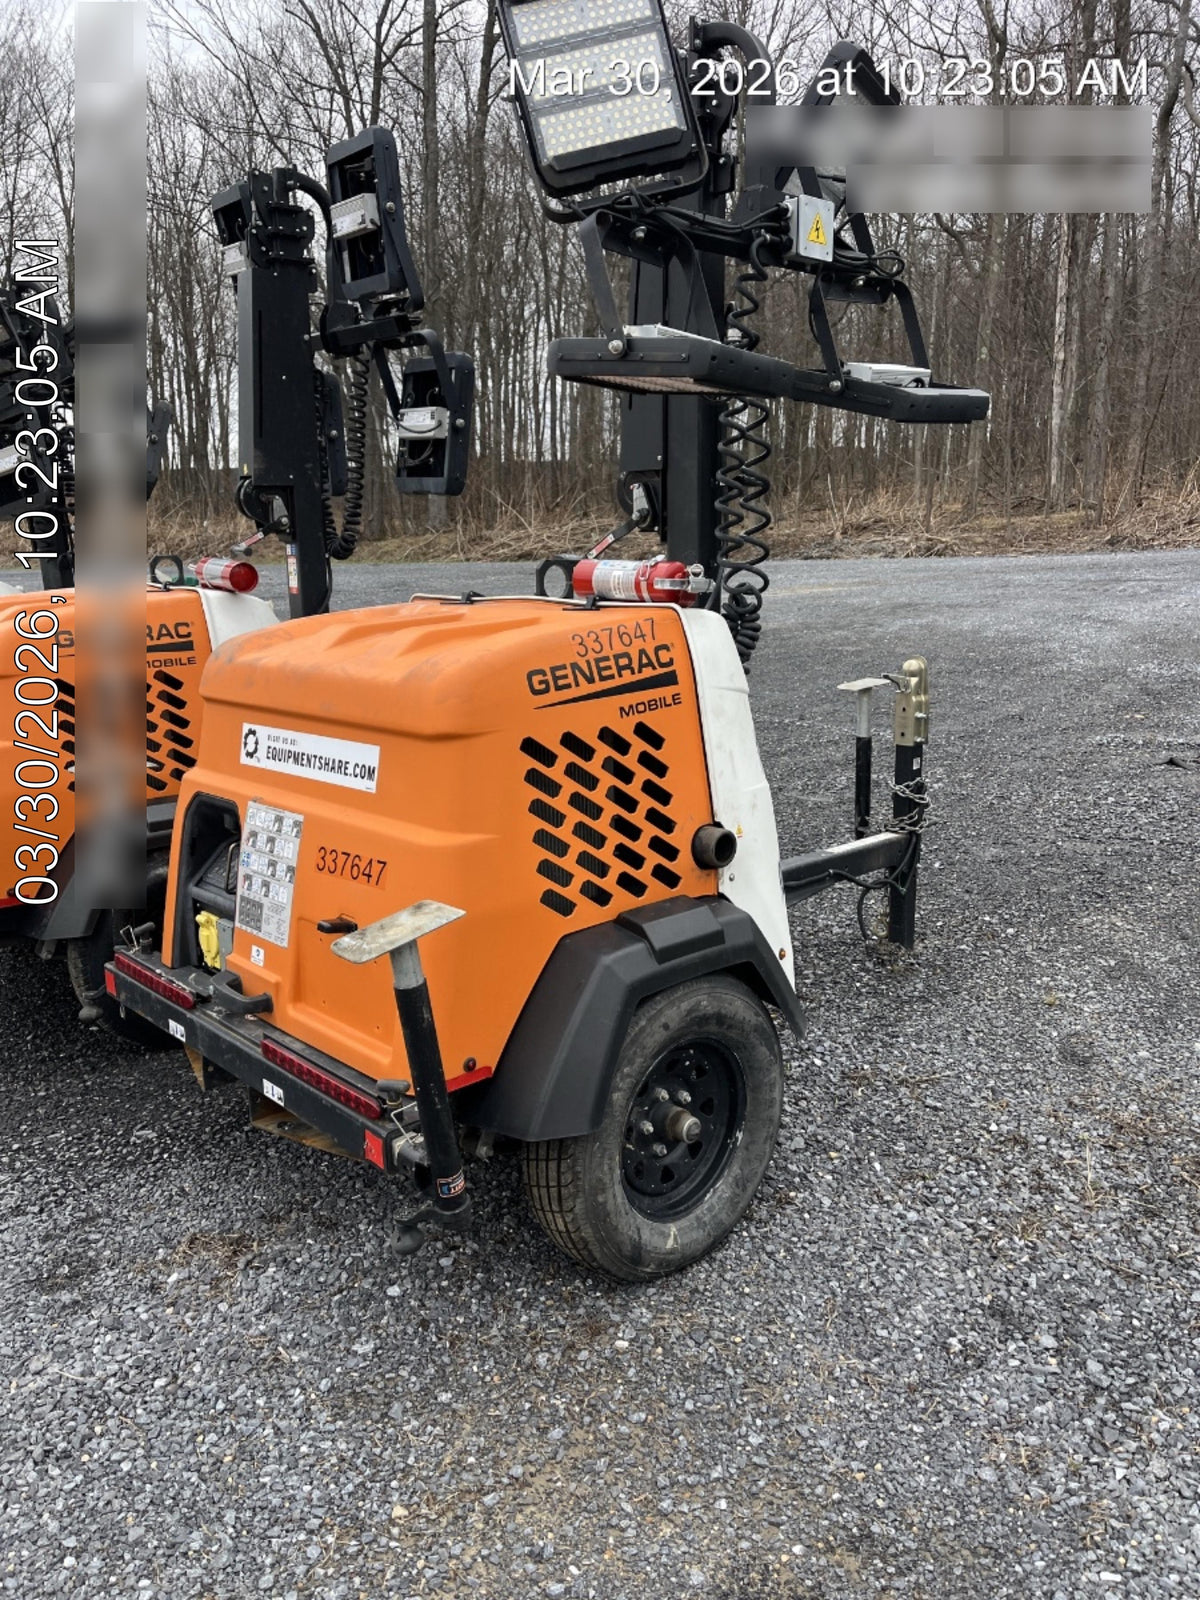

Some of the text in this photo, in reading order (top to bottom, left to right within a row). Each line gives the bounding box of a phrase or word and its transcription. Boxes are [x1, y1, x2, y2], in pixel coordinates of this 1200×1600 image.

[571, 617, 657, 658] 337647
[146, 656, 197, 669] OBILE
[526, 643, 675, 696] GENERAC
[619, 692, 682, 718] MOBILE
[266, 746, 376, 781] EQUIPMENTSHARE.COM
[316, 846, 387, 886] 337647
